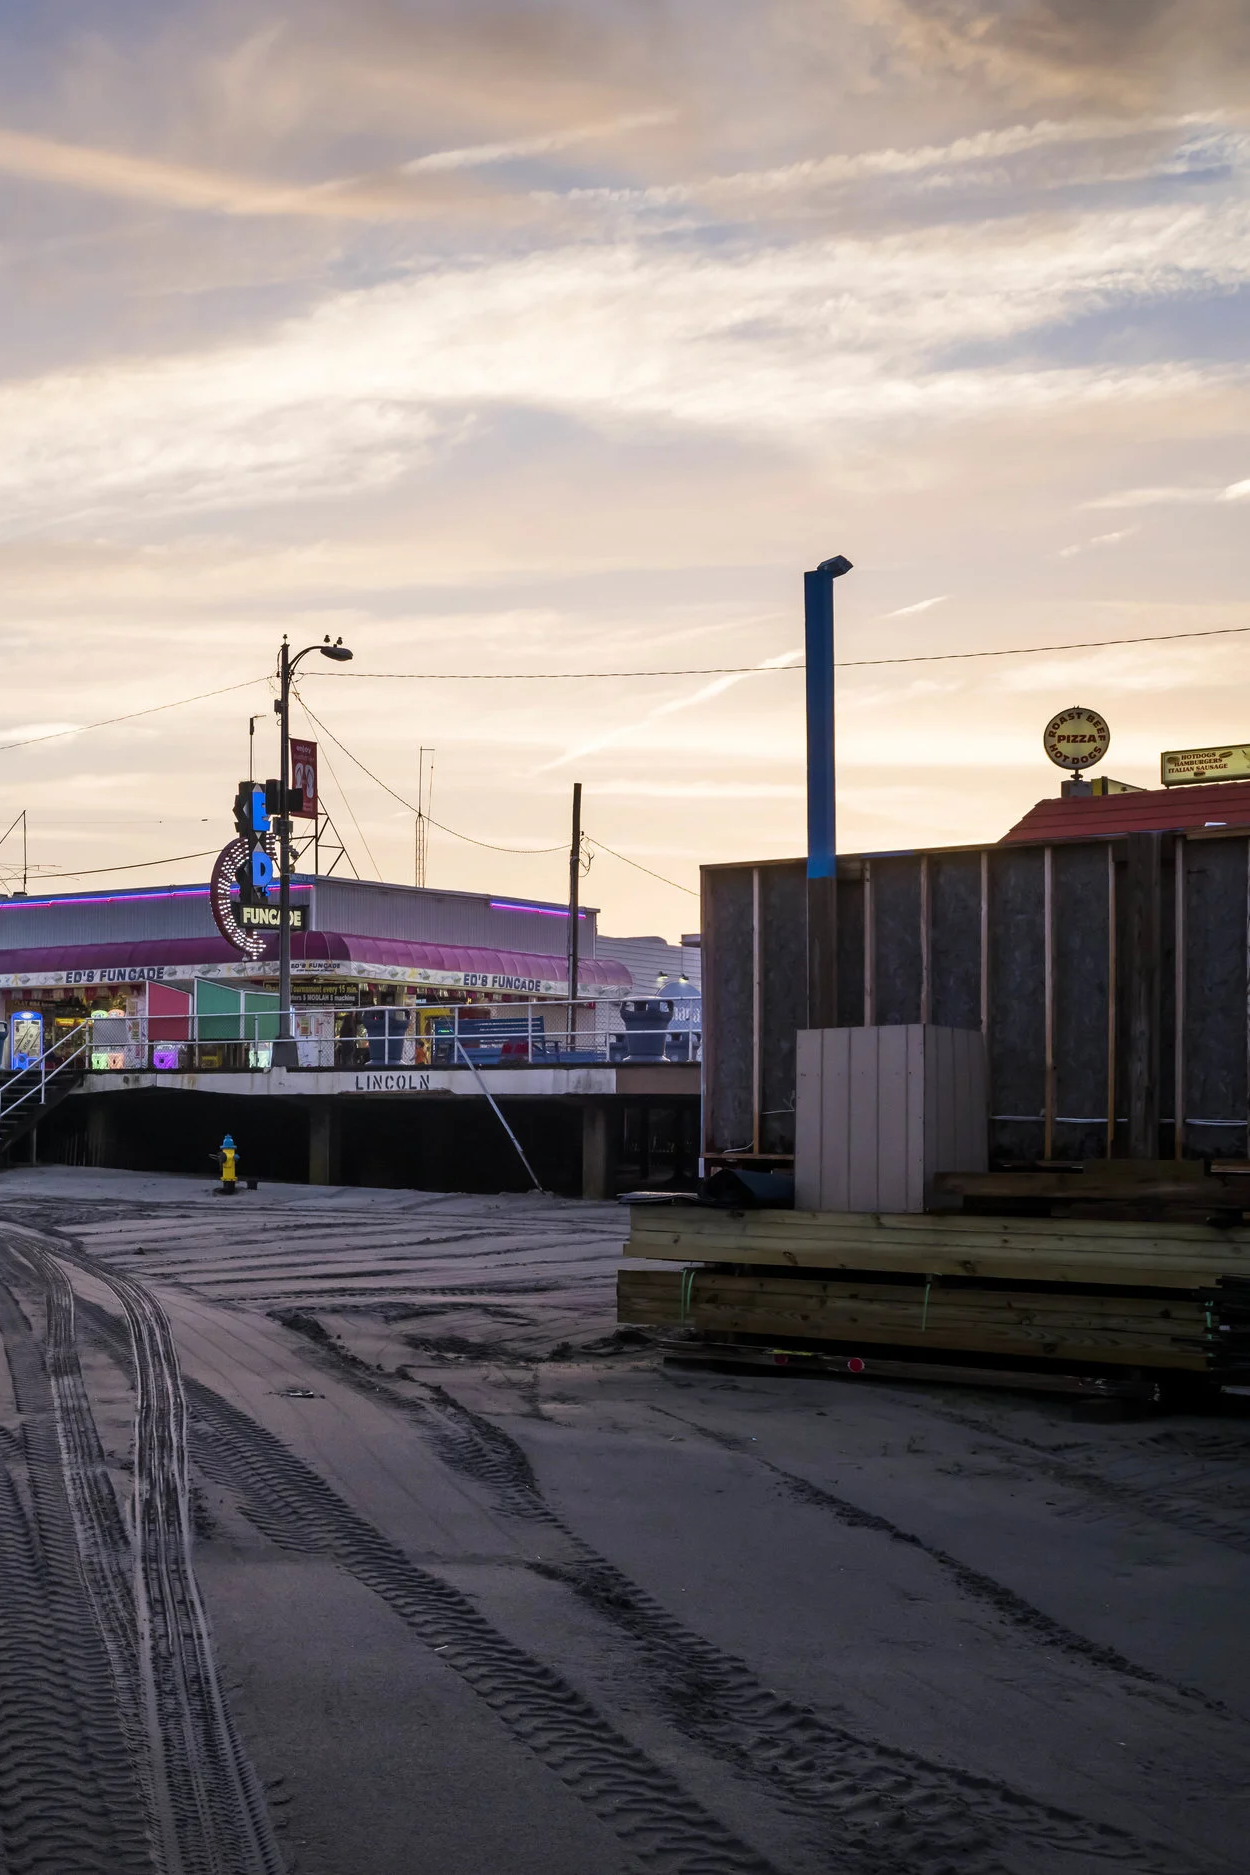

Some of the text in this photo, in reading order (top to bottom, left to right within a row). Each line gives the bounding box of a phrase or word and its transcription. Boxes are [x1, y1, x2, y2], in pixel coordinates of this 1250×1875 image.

[1048, 712, 1106, 741] ROAST BEEF
[1057, 734, 1097, 743] PIZZA
[1049, 744, 1102, 764] HOT DOGS
[1181, 752, 1216, 760] HOTDOGS
[1168, 763, 1228, 774] ITALIAN SAUSAGE
[1174, 758, 1223, 767] HAMBURGERS
[66, 967, 165, 983] ED'S FUNCADE
[339, 984, 345, 993] 15
[463, 973, 541, 992] ED'S FUNCADE
[356, 1074, 430, 1090] LINCOLN
